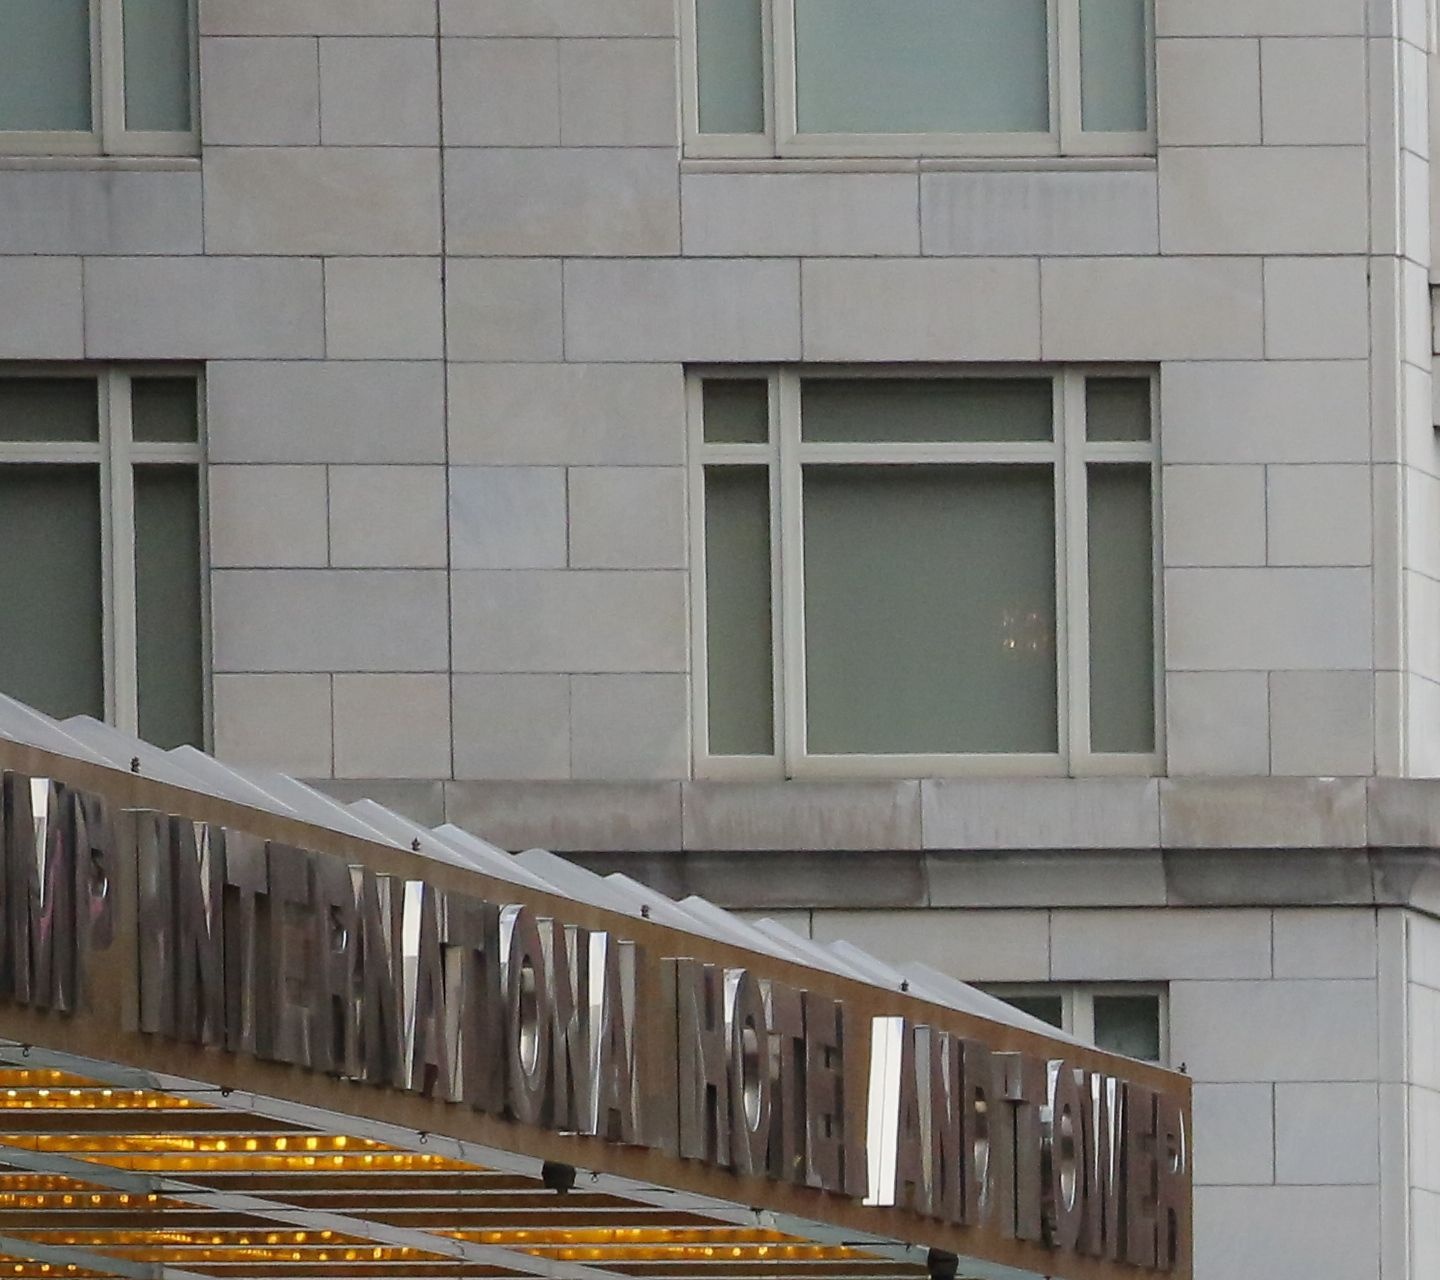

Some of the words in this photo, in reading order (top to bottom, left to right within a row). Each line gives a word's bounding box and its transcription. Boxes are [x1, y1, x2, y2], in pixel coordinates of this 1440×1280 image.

[122, 808, 660, 1150] INTERNATIONAL
[661, 957, 868, 1200] HOTEL
[864, 1016, 993, 1227] AND
[991, 1051, 1187, 1272] TOWER
